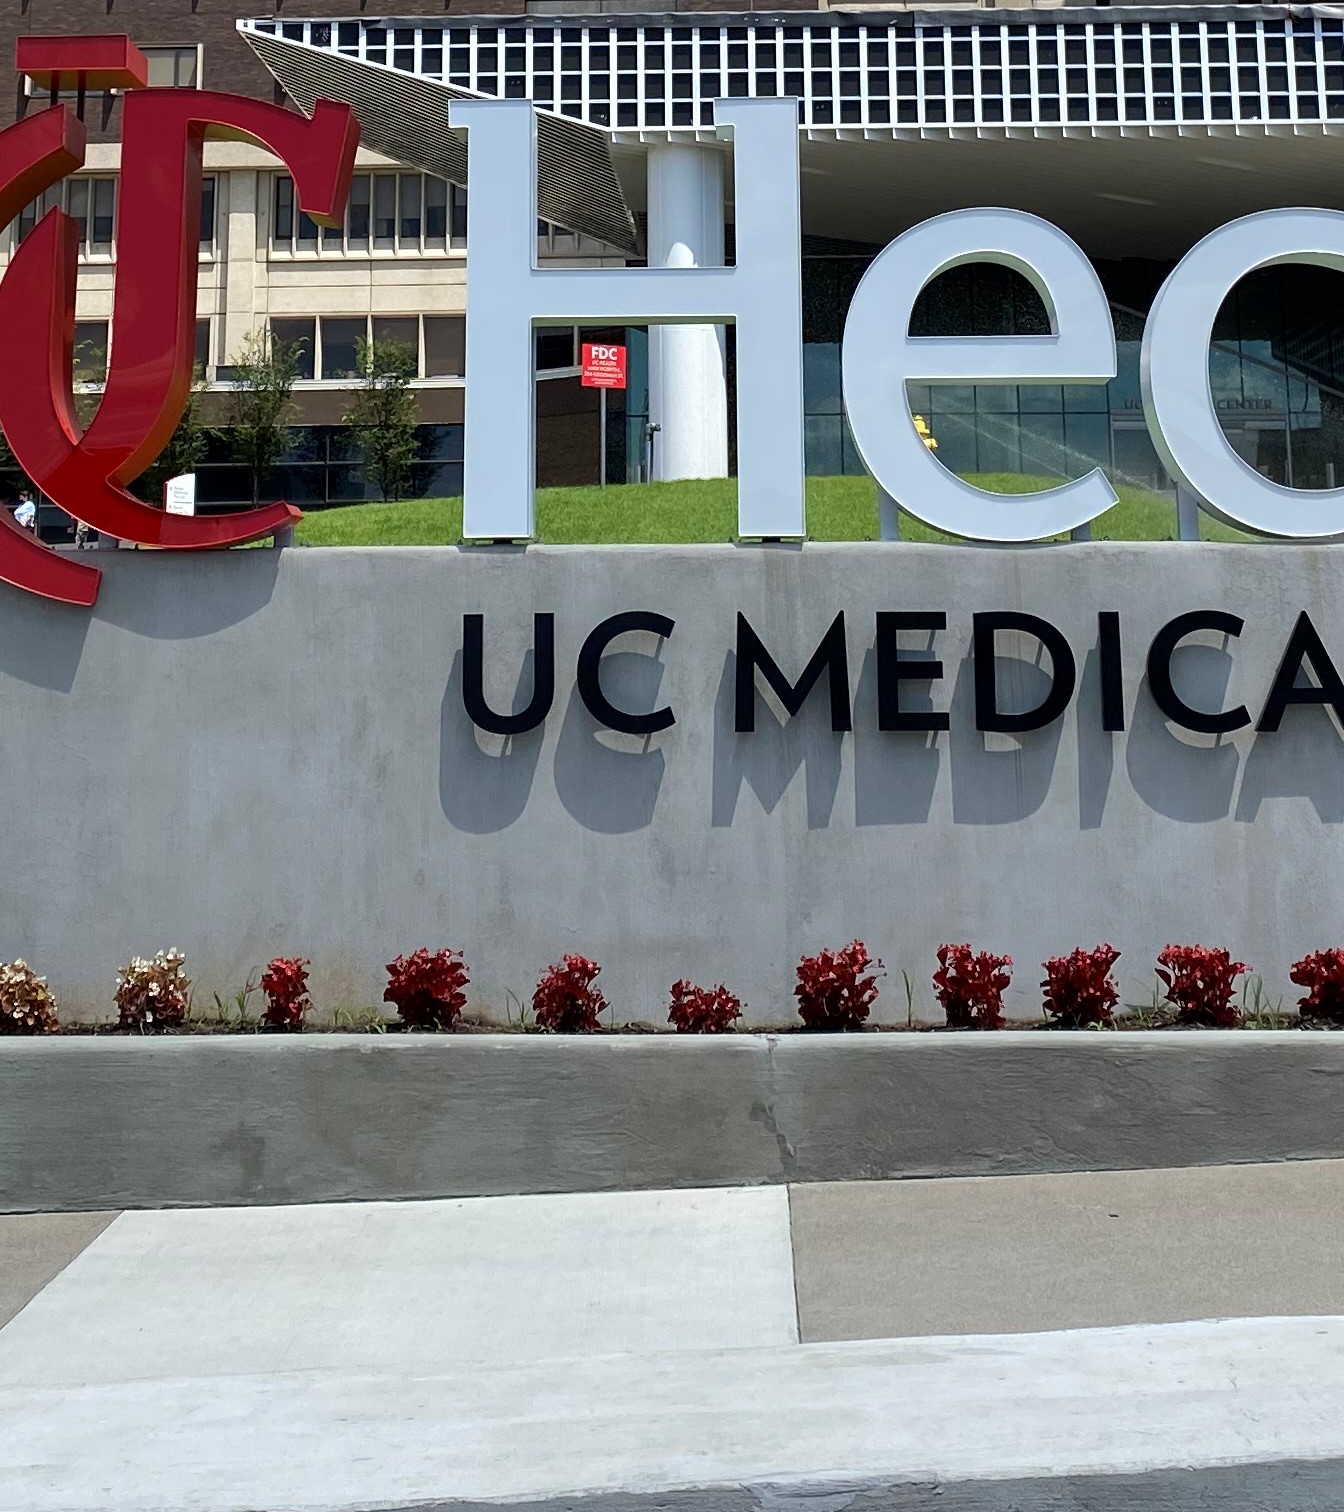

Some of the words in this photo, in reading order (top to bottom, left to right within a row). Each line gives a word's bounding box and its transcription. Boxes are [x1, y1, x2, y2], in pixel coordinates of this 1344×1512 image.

[591, 346, 618, 361] FDC
[1216, 399, 1273, 410] CENTER
[460, 610, 677, 735] UC
